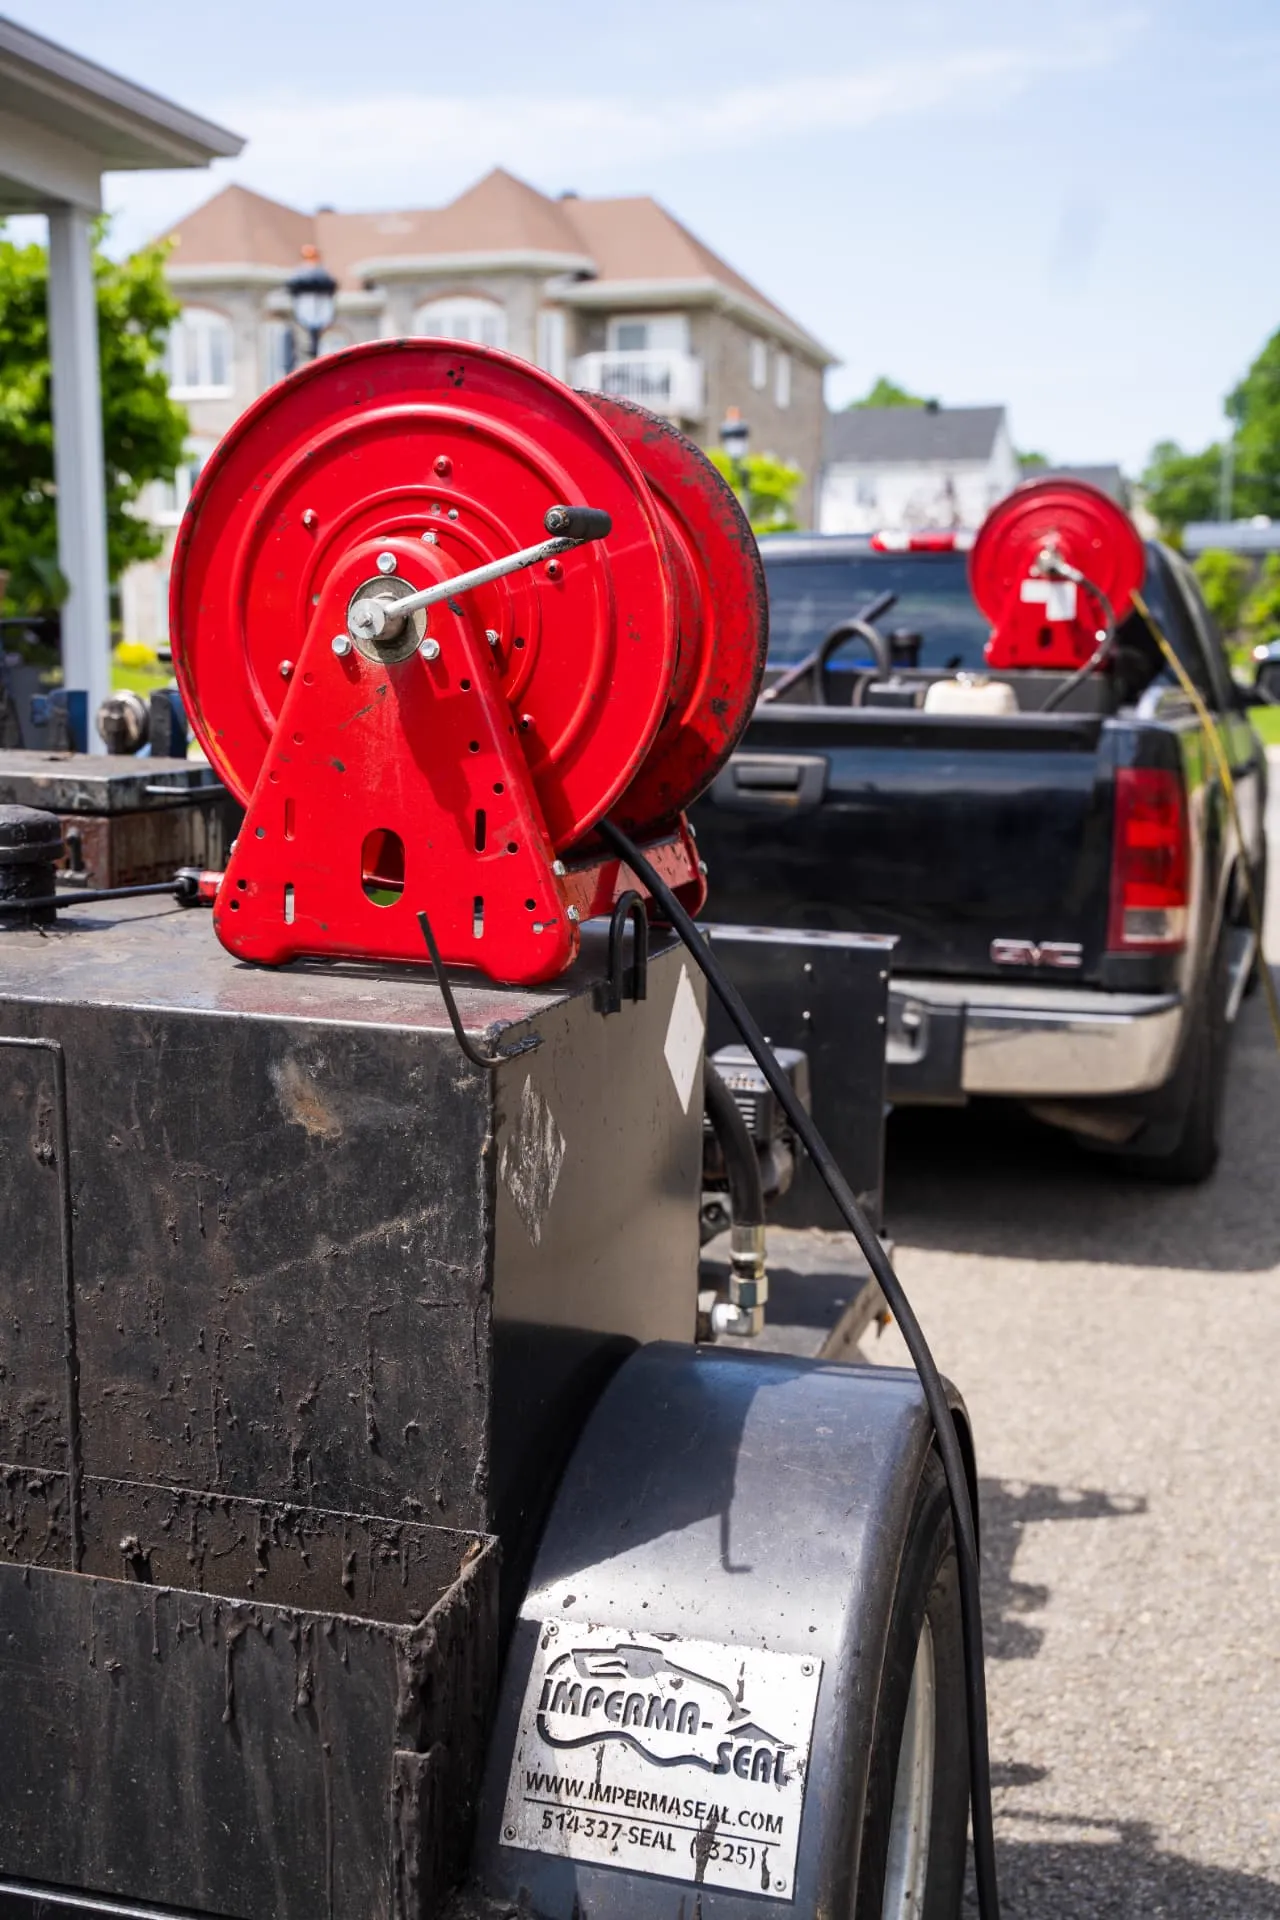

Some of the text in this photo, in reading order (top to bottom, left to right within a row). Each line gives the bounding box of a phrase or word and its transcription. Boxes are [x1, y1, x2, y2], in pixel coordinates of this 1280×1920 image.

[989, 938, 1083, 968] GMC
[712, 1741, 789, 1787] SEAL
[526, 1771, 784, 1834] WWW.IMPERMASEAL.COM
[541, 1809, 756, 1870] 514-327-SEAL (325)
